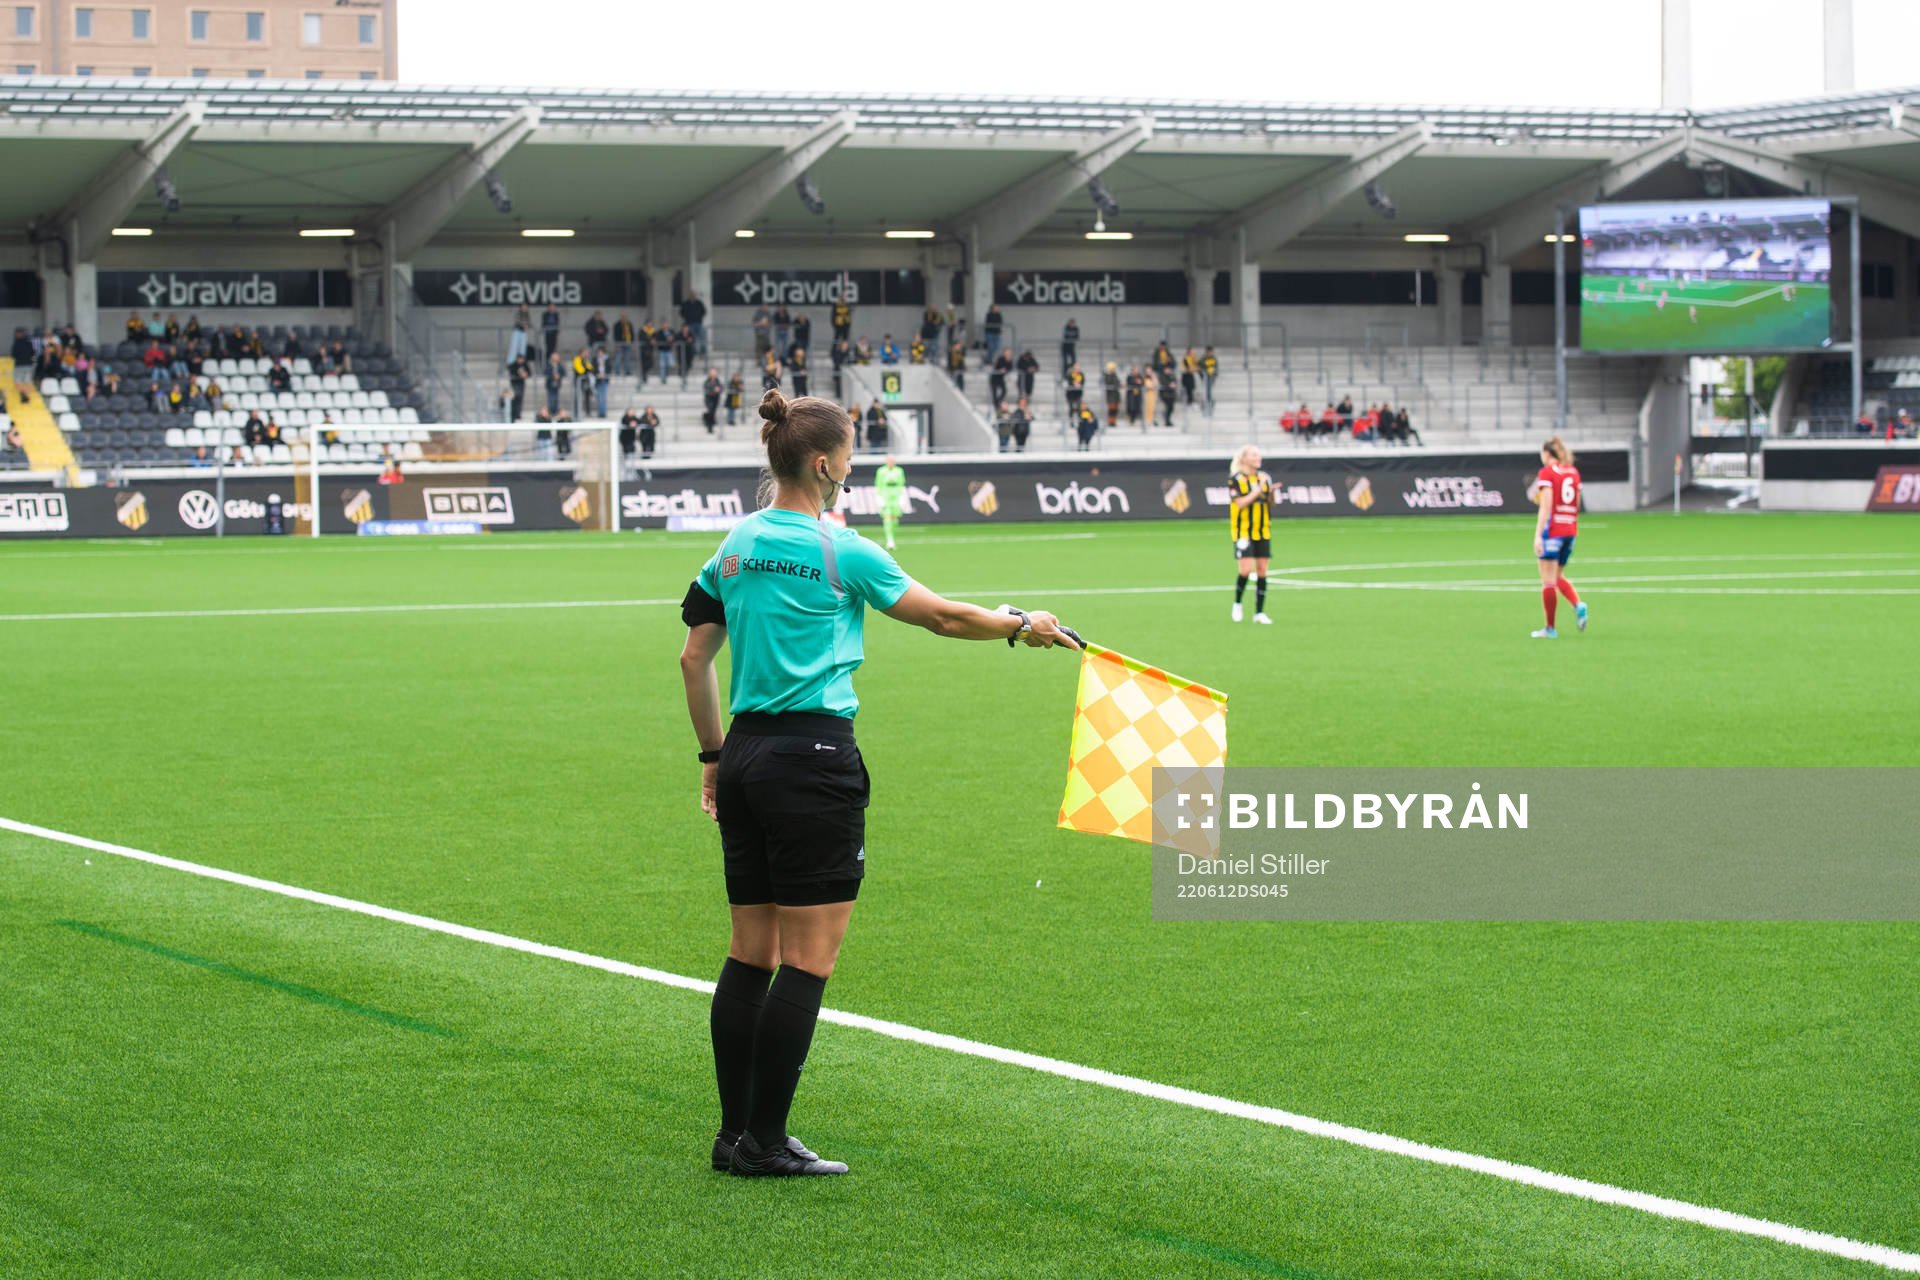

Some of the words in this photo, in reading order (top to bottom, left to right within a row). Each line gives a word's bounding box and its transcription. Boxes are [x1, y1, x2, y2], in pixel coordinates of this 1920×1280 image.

[169, 274, 277, 304] bravida
[478, 274, 582, 303] bravida
[762, 273, 859, 303] bravida
[1034, 274, 1126, 303] bravida
[433, 495, 506, 512] BRA
[621, 489, 743, 517] stadium
[1035, 481, 1130, 514] brion
[1561, 476, 1575, 505] 6
[742, 558, 822, 582] SCHENKER
